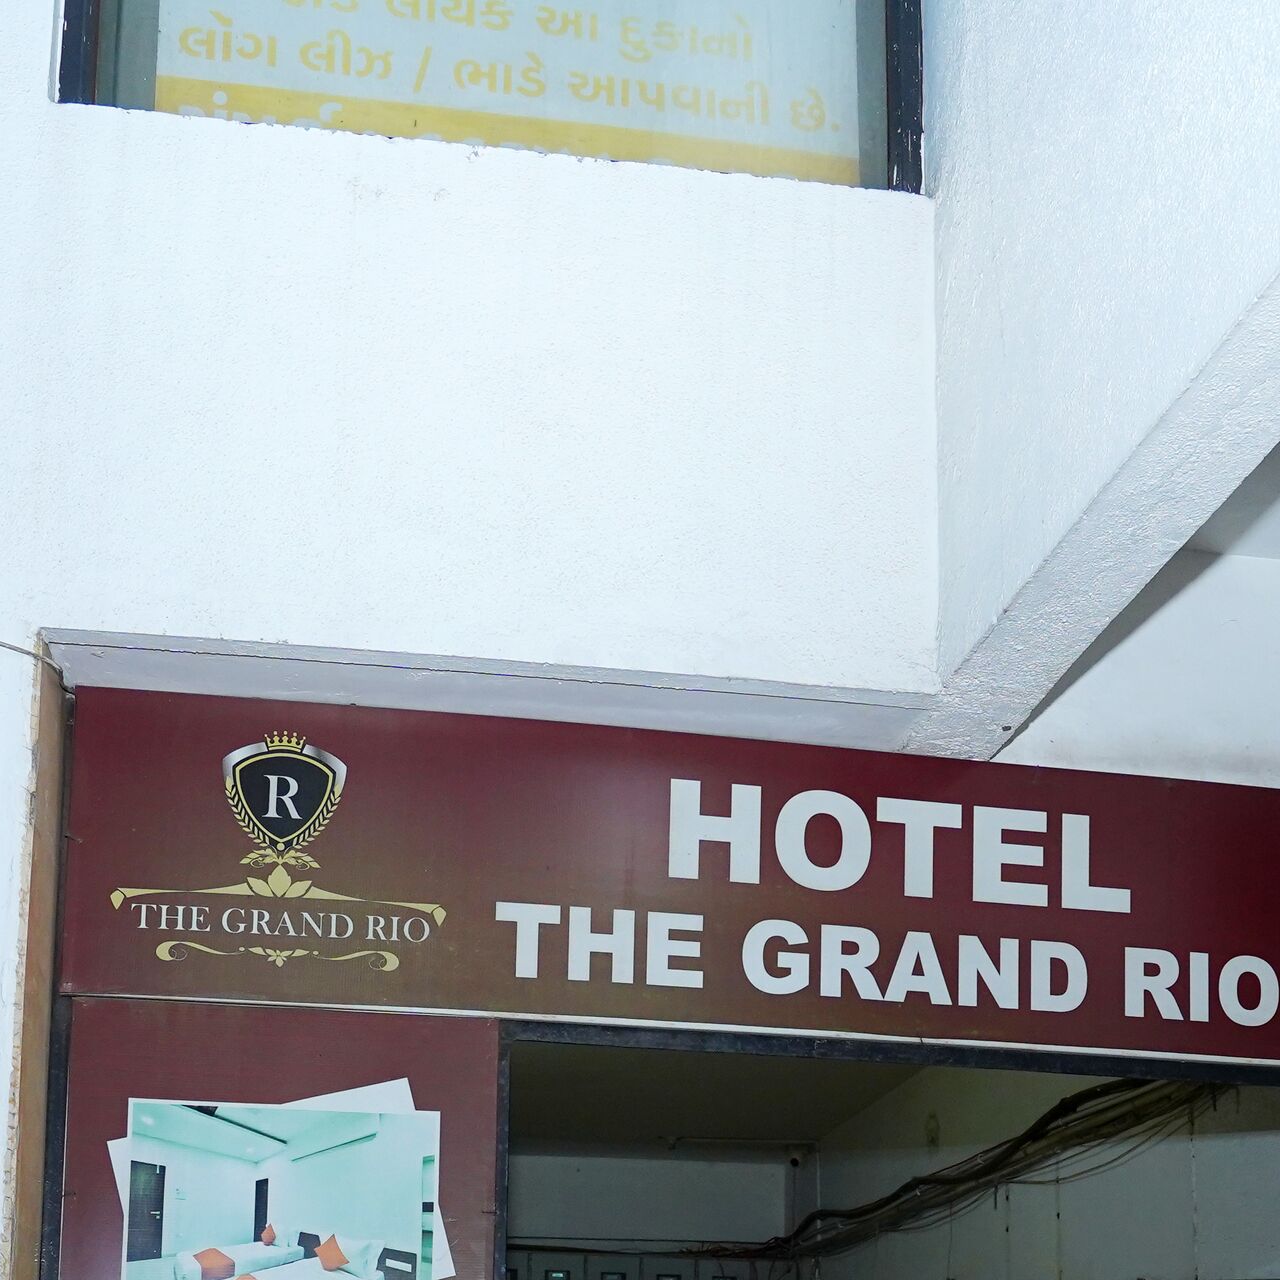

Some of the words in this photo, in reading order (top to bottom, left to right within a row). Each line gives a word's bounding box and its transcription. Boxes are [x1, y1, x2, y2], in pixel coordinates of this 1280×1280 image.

[536, 5, 599, 41] આ
[299, 29, 393, 79] લીઝ
[453, 51, 547, 98] ભાડે
[568, 70, 769, 127] આપવાની
[261, 774, 303, 820] R
[668, 778, 1131, 914] HOTEL
[130, 902, 212, 933] THE
[221, 906, 354, 940] GRAND
[365, 915, 431, 944] RIO
[494, 901, 706, 989] THE
[741, 918, 1089, 1013] GRAND
[1123, 946, 1280, 1027] RIO
